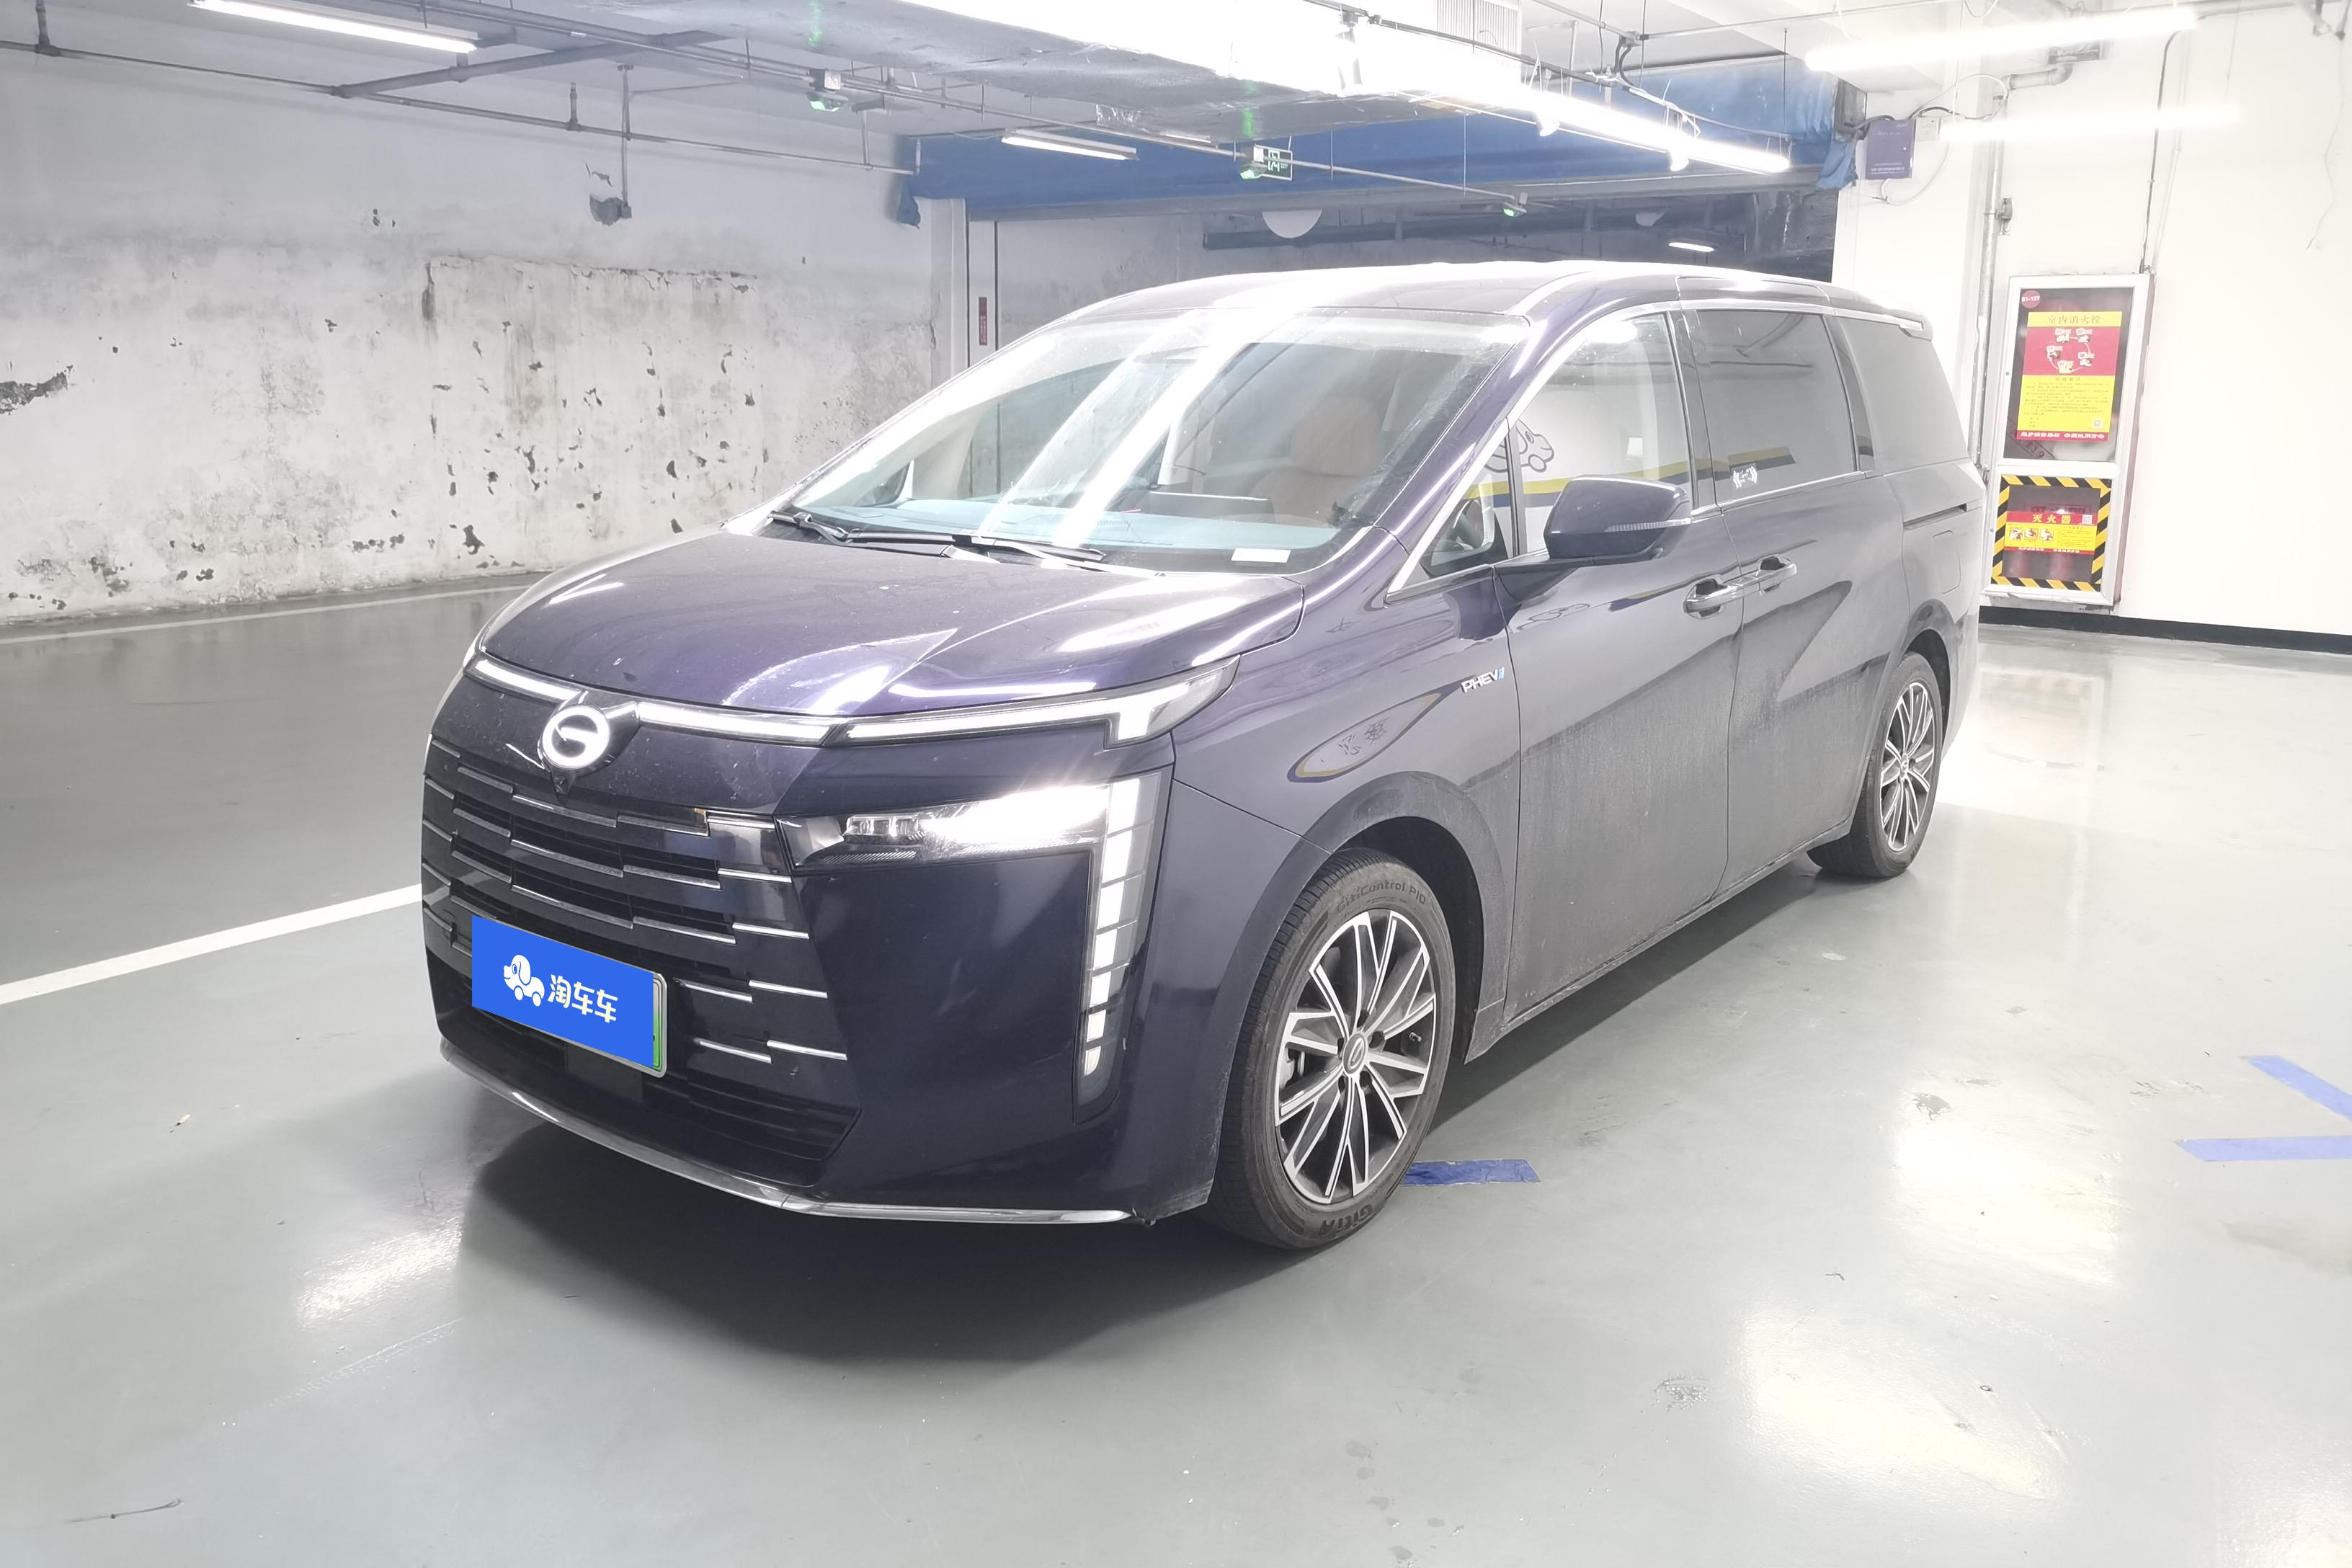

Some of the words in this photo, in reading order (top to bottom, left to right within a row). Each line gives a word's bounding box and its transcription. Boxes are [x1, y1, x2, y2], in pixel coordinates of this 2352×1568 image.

[2047, 315, 2101, 324] 室内消火栓
[2032, 514, 2072, 525] 灭火器
[1461, 669, 1500, 693] PHEV
